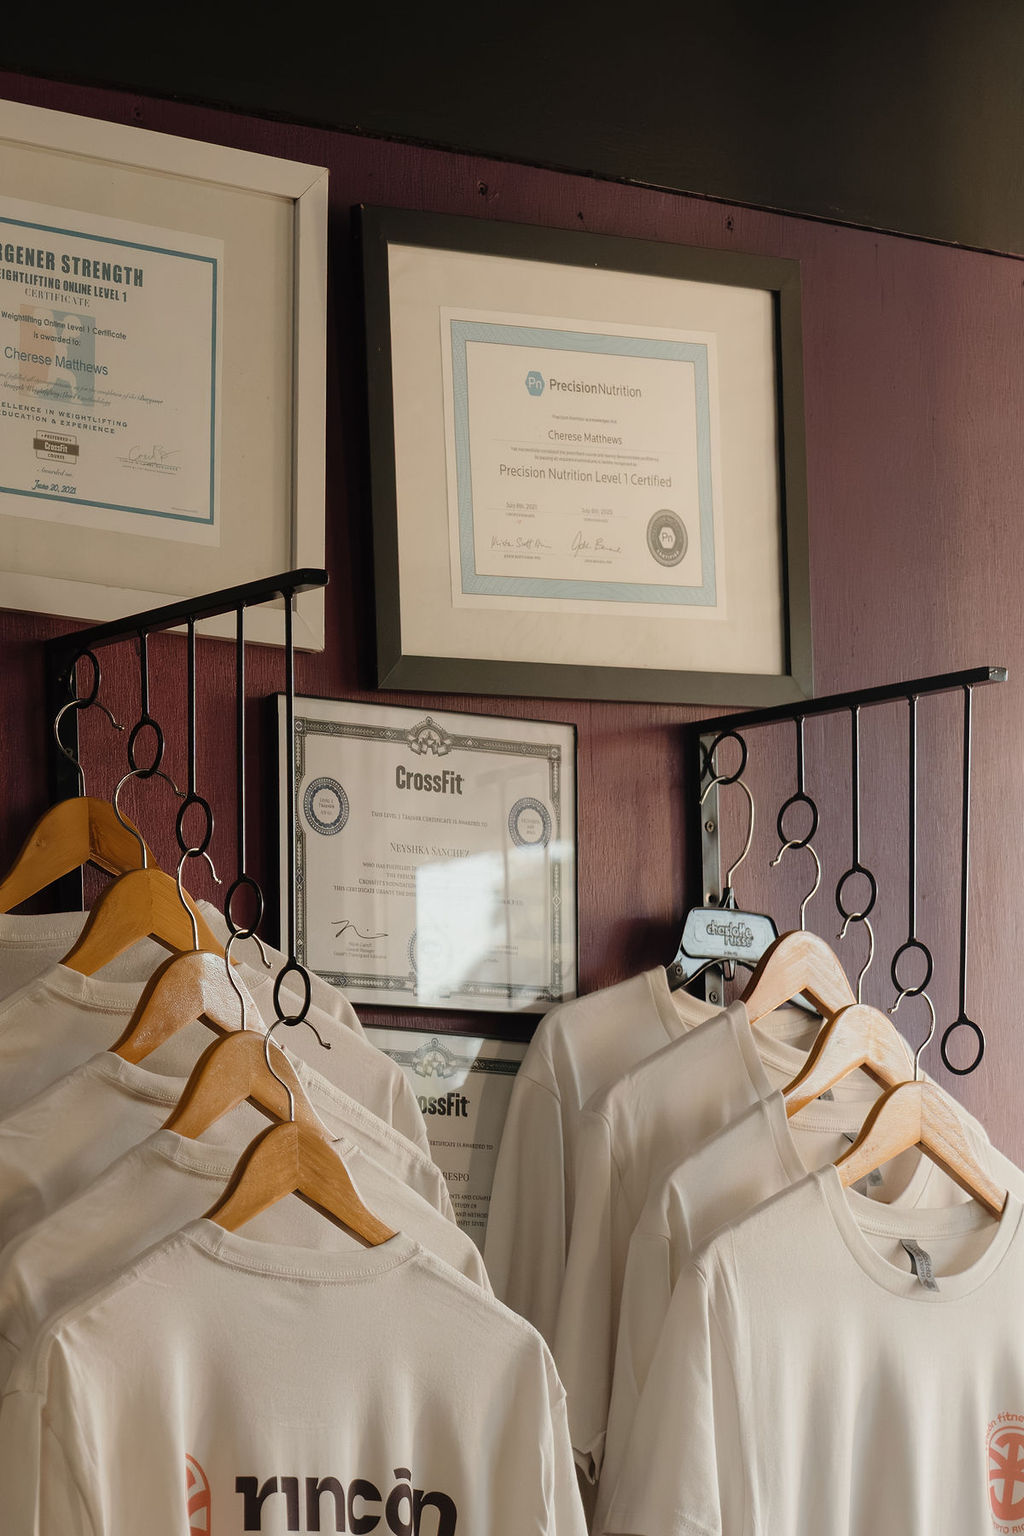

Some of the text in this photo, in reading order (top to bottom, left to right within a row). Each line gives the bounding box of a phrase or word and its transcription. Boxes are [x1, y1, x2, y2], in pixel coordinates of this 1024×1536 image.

[61, 254, 144, 287] STRENGTH
[25, 288, 90, 308] CERTIFICATE
[63, 280, 91, 296] ONLINE
[94, 285, 119, 301] LEVEL
[121, 291, 128, 302] 1
[1, 310, 42, 327] Weightlifting
[44, 318, 65, 329] Online
[67, 322, 85, 333] Level
[93, 326, 126, 340] Certificate
[41, 333, 70, 344] awarded
[4, 347, 108, 376] Cherese Matthews
[528, 378, 541, 390] Pn
[45, 408, 54, 416] IN
[58, 410, 128, 428] WEIGHTLIFTING
[60, 419, 115, 434] EXPERIENCE
[45, 442, 67, 453] CrossFit
[548, 430, 622, 445] Cherese Matthews
[499, 464, 671, 488] Precision Nutrition Level 1 Certified
[396, 765, 462, 795] CrossFit
[390, 842, 429, 855] NEYSHKA
[416, 1093, 468, 1117] ossFit
[442, 1171, 470, 1182] RESPO
